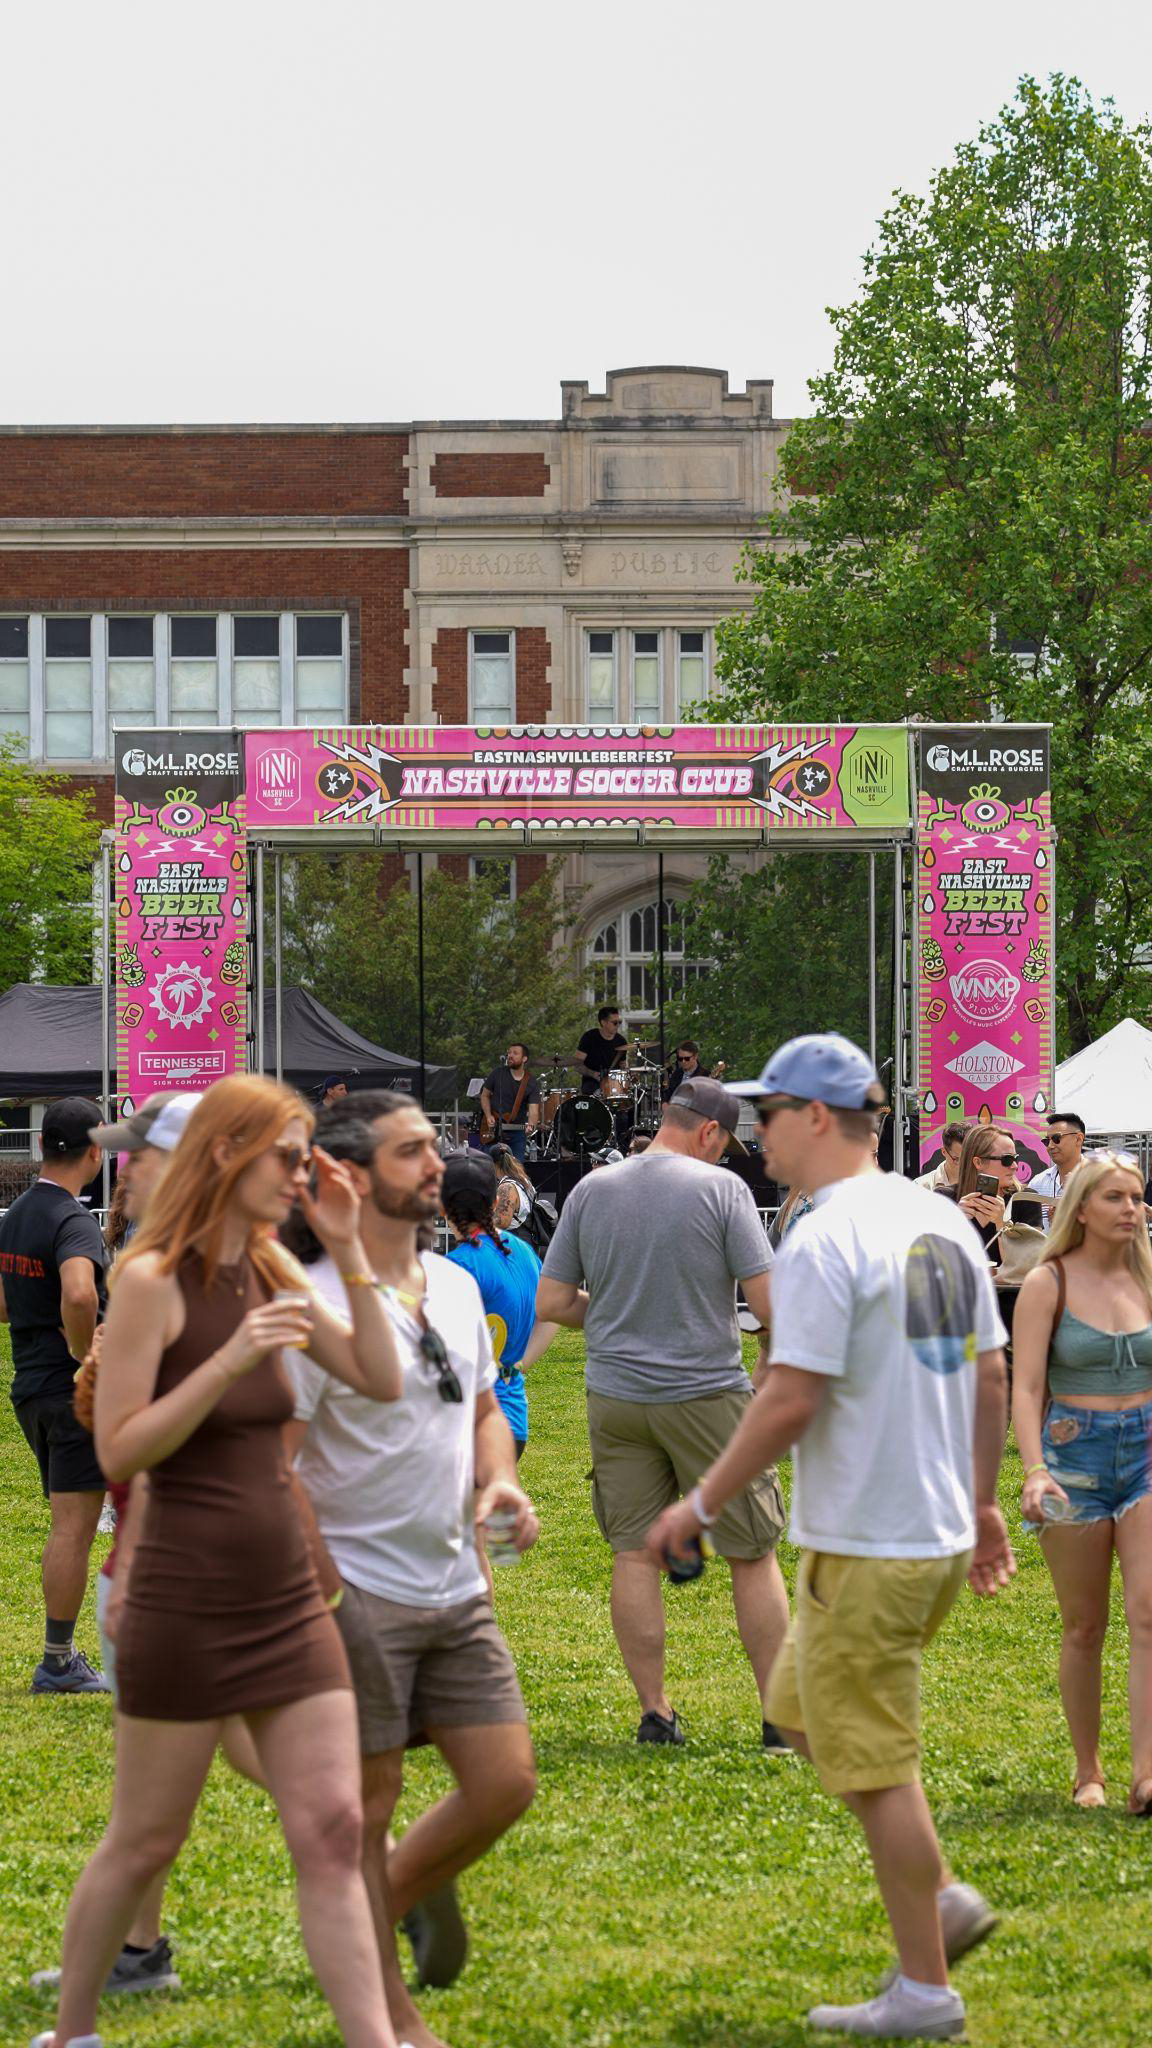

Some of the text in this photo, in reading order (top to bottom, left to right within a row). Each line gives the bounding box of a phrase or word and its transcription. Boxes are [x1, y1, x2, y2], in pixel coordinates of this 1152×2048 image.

[436, 552, 722, 577] WARNER PUBLIC
[474, 751, 673, 764] EASTNASHVILLEBEERFEST
[401, 768, 753, 795] NASHVILLE SOCCER CLUB
[856, 785, 887, 793] NASHVILLE
[262, 789, 294, 798] NASHVILLE
[274, 798, 282, 806] SC
[159, 863, 203, 878] EAST
[962, 859, 1007, 874] EAST
[135, 878, 228, 894] NASHVILLE
[938, 874, 1032, 889] NASHVILLE
[139, 894, 223, 916] BEER
[943, 890, 1027, 911] BEER
[141, 916, 224, 939] FEST
[945, 912, 1028, 935] FEST
[949, 976, 1020, 998] WNXP
[144, 1057, 220, 1069] TENNESSEE
[954, 1056, 1015, 1072] HOLSTON
